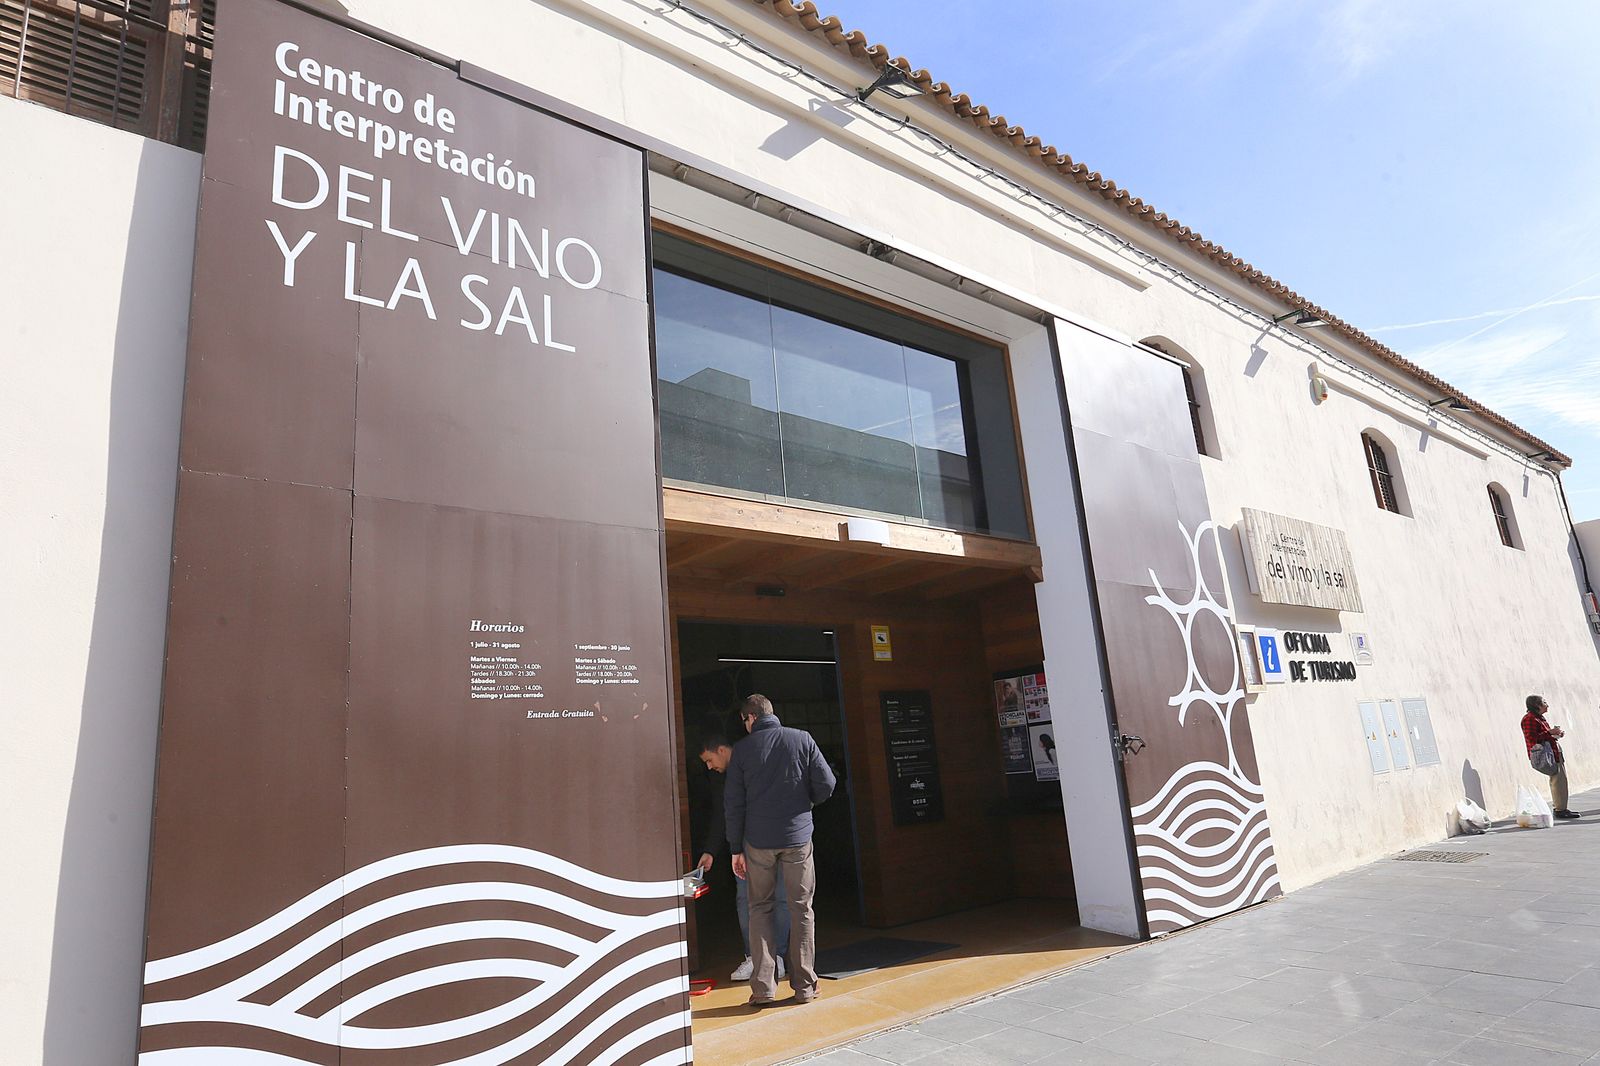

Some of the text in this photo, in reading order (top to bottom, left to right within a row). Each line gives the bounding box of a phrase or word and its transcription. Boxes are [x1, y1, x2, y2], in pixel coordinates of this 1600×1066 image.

[274, 41, 456, 134] Centro de
[274, 79, 536, 199] Interpretación
[271, 145, 602, 290] DEL VINO
[265, 220, 576, 353] Y LA SAL
[1271, 544, 1308, 557] nterpretación
[1268, 554, 1348, 590] del vino y la sal
[470, 620, 524, 632] Horarios
[1284, 632, 1332, 654] OFICINA
[1289, 660, 1356, 682] DE TURISMO
[527, 709, 594, 718] Entrada Gratuita
